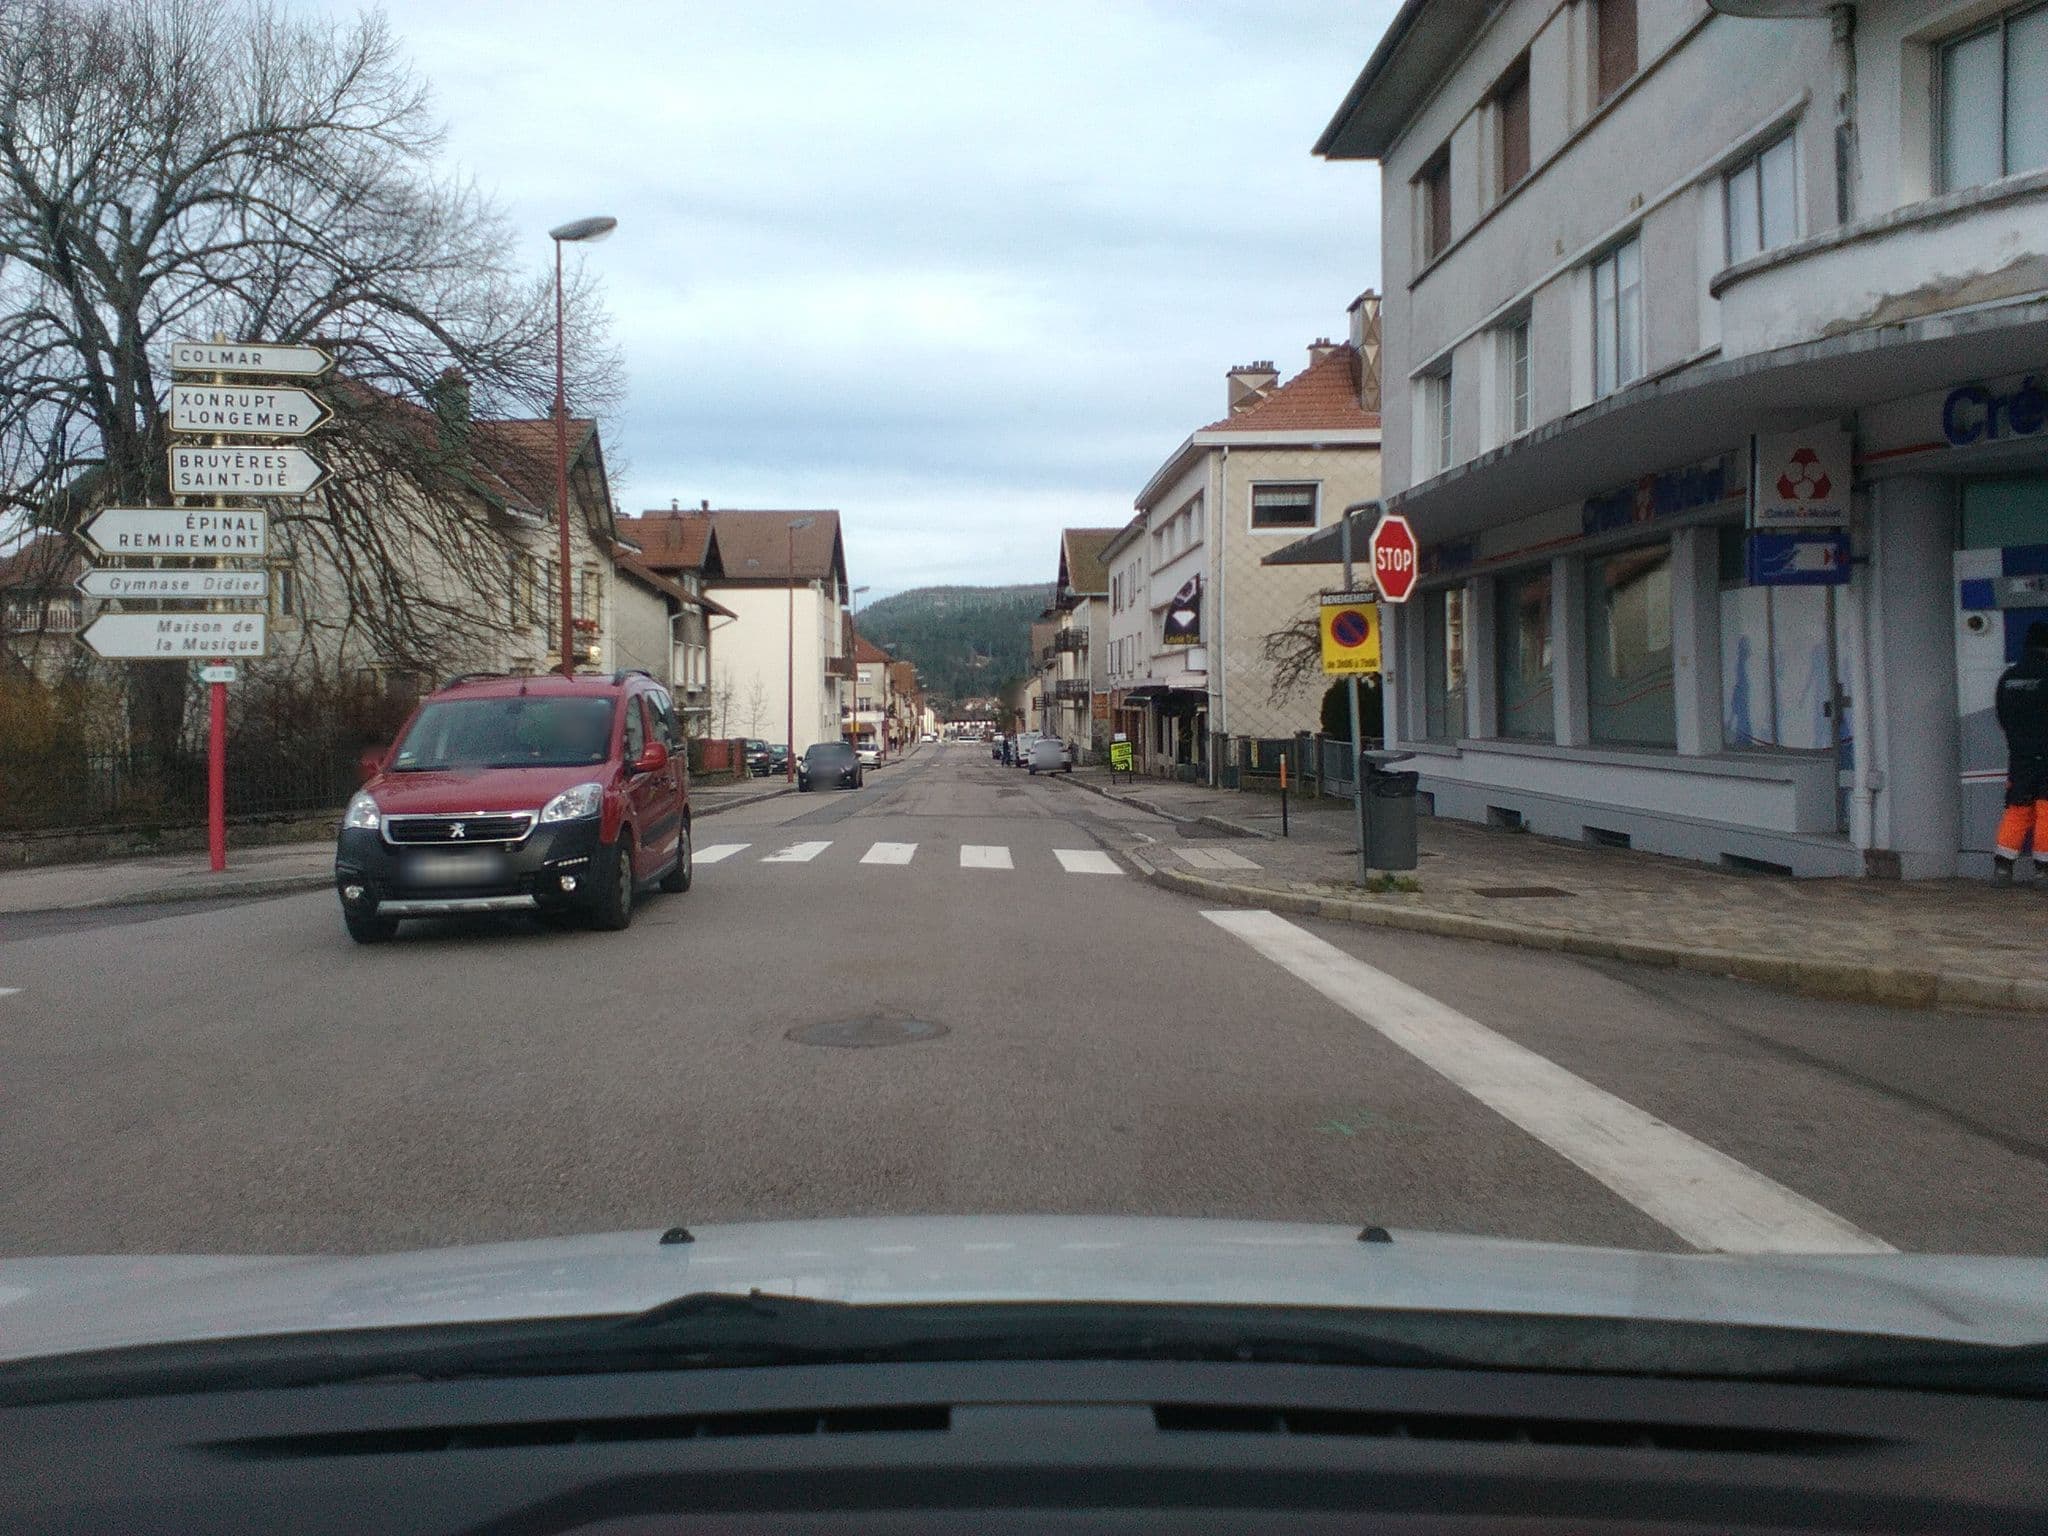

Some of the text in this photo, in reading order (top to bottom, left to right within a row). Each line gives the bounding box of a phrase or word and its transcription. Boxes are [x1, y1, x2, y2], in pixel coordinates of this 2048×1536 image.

[180, 349, 263, 366] COLMAR
[180, 393, 277, 409] XONRUPT
[180, 410, 300, 428] -LONGEMER
[179, 450, 288, 469] BRUYÈRES
[180, 467, 288, 487] SAINT-DIÉ
[185, 513, 260, 531] ÉPINAL
[119, 533, 260, 549] REMIREMONT
[1376, 546, 1413, 573] STOP
[109, 576, 261, 592] Gymnase Didier
[156, 618, 254, 633] Maison de
[156, 637, 260, 655] la Musique
